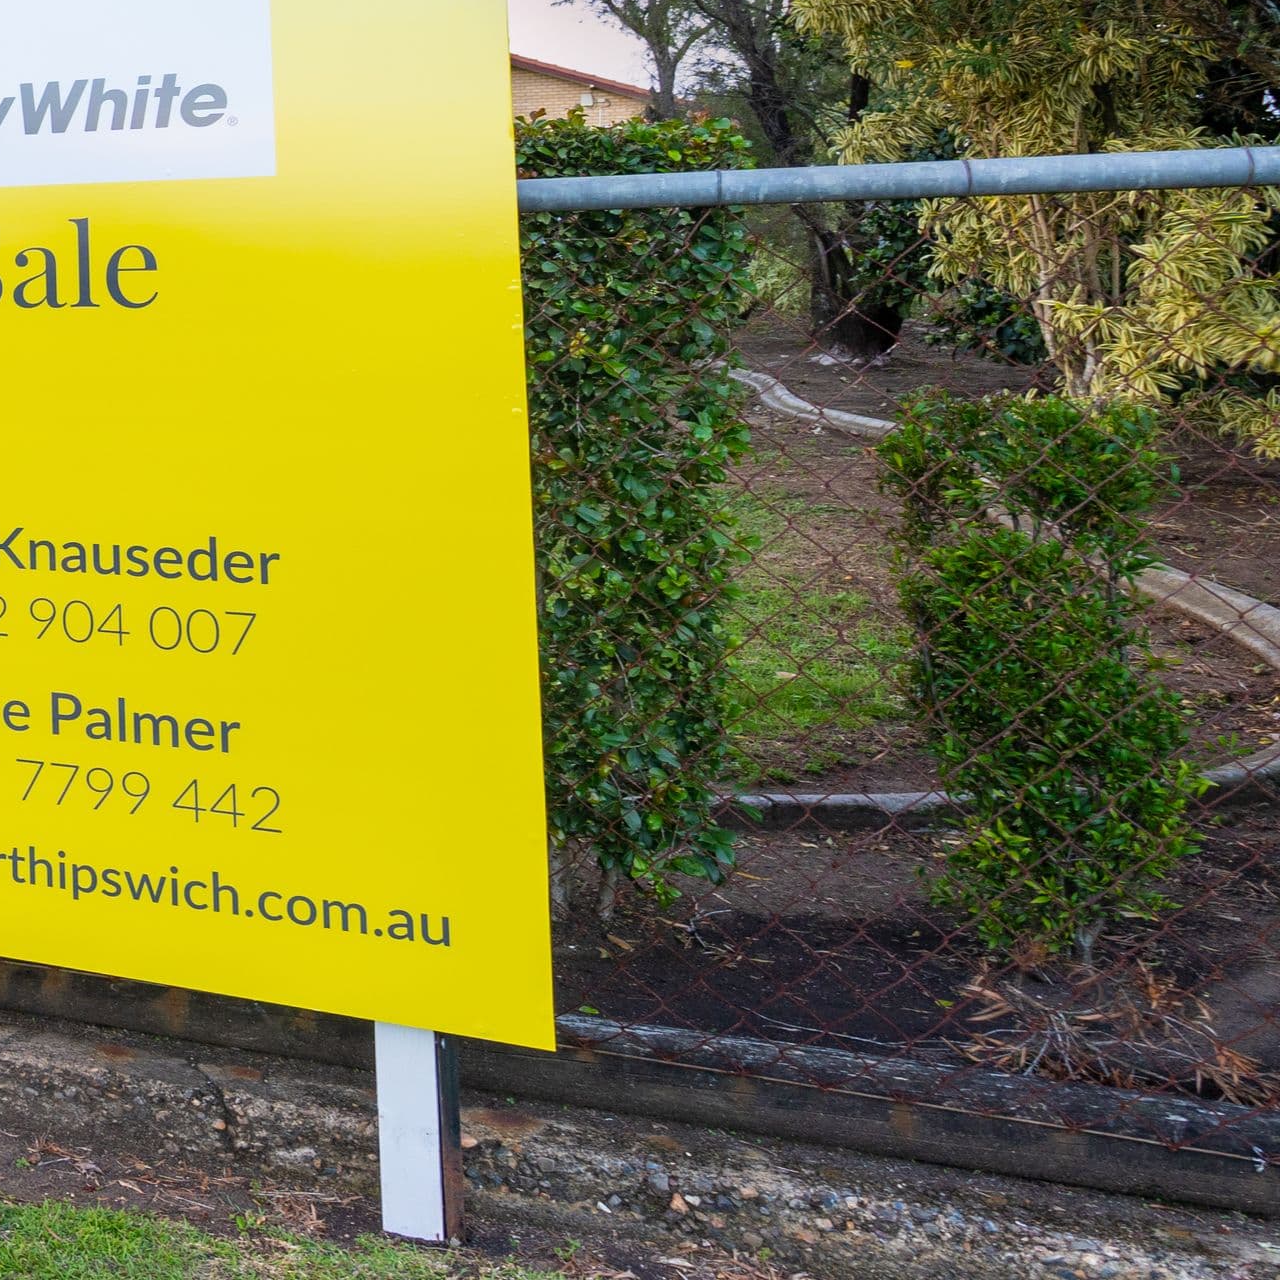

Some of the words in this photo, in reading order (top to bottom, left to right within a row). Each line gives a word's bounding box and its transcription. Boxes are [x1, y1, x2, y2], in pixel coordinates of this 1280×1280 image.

[29, 597, 131, 647] 904
[149, 606, 257, 656] 007
[50, 691, 241, 754] Palmer
[15, 758, 151, 815] 7799
[172, 778, 283, 834] 442
